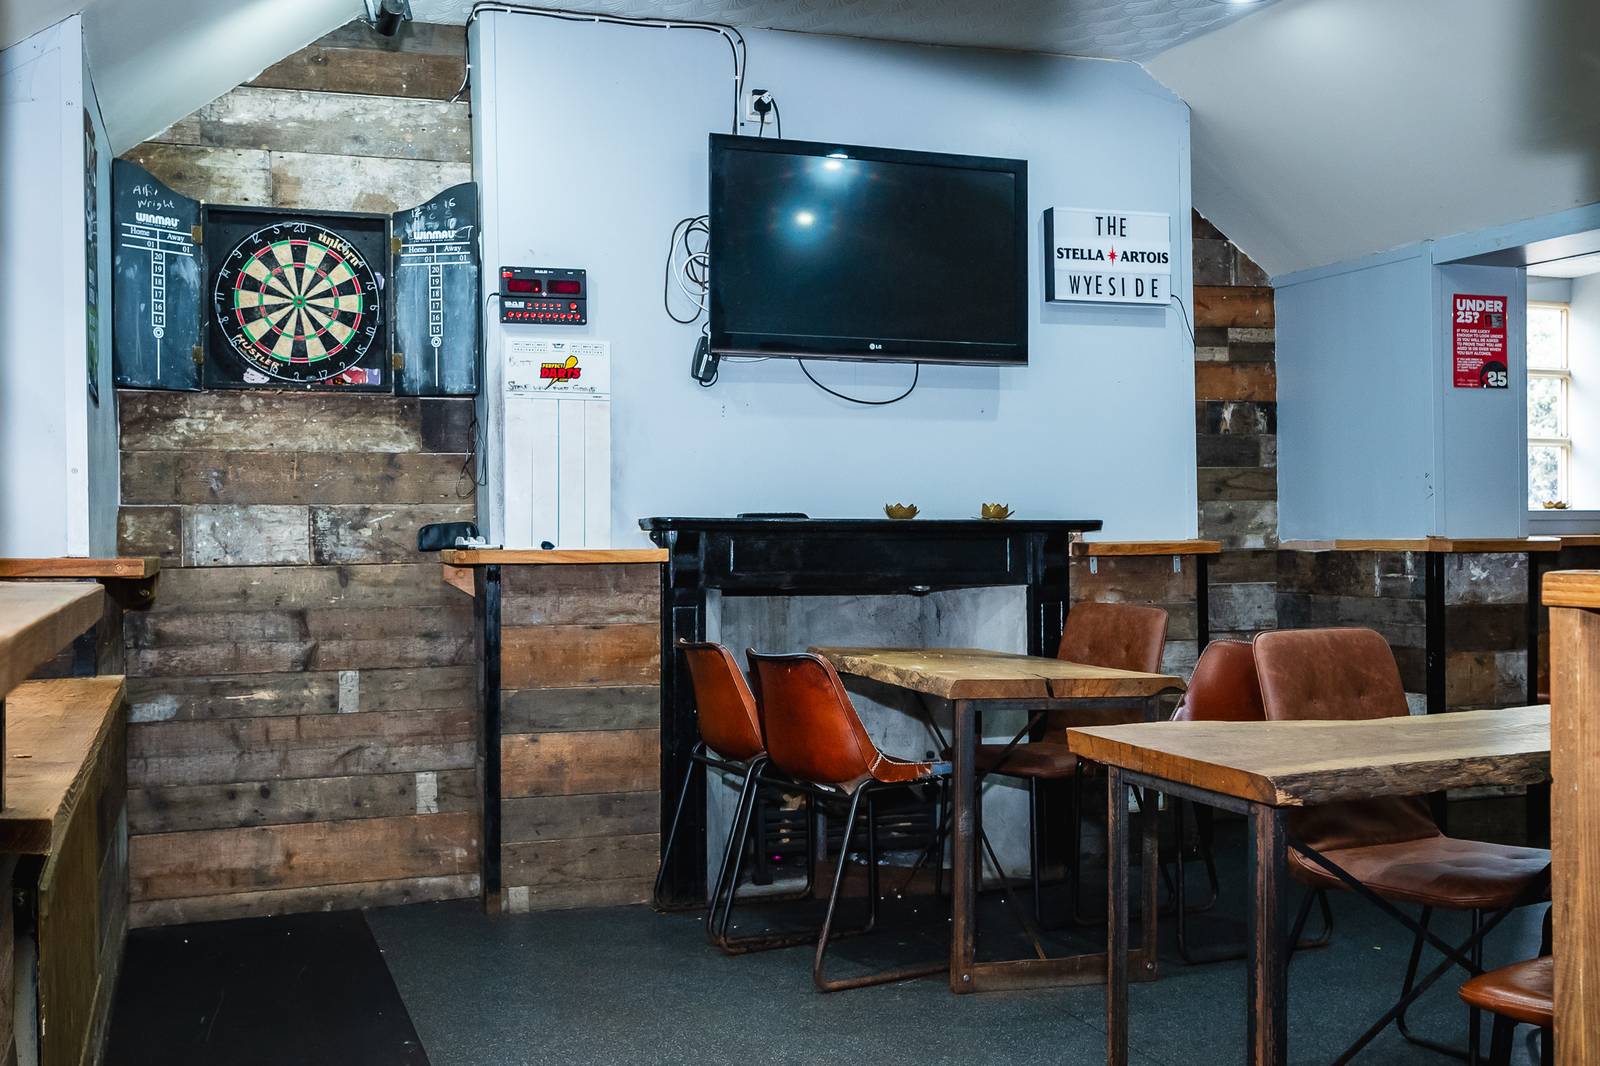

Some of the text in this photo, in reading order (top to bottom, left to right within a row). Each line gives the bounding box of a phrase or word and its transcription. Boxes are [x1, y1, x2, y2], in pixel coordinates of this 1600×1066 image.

[138, 200, 175, 210] Wright
[444, 198, 456, 208] 16
[136, 212, 180, 228] WINMAU
[130, 226, 150, 236] Home
[293, 224, 306, 234] 20
[1096, 216, 1126, 238] THE
[166, 233, 185, 244] Away
[154, 252, 163, 260] 20
[318, 234, 360, 266] unicorn
[1056, 248, 1169, 264] STELLA ARTOIS
[1069, 275, 1158, 298] WYESIDE
[1456, 298, 1503, 312] UNDER
[154, 316, 163, 324] 15
[1456, 311, 1480, 324] 25?
[541, 368, 582, 379] DARTS
[1488, 372, 1507, 386] 25
